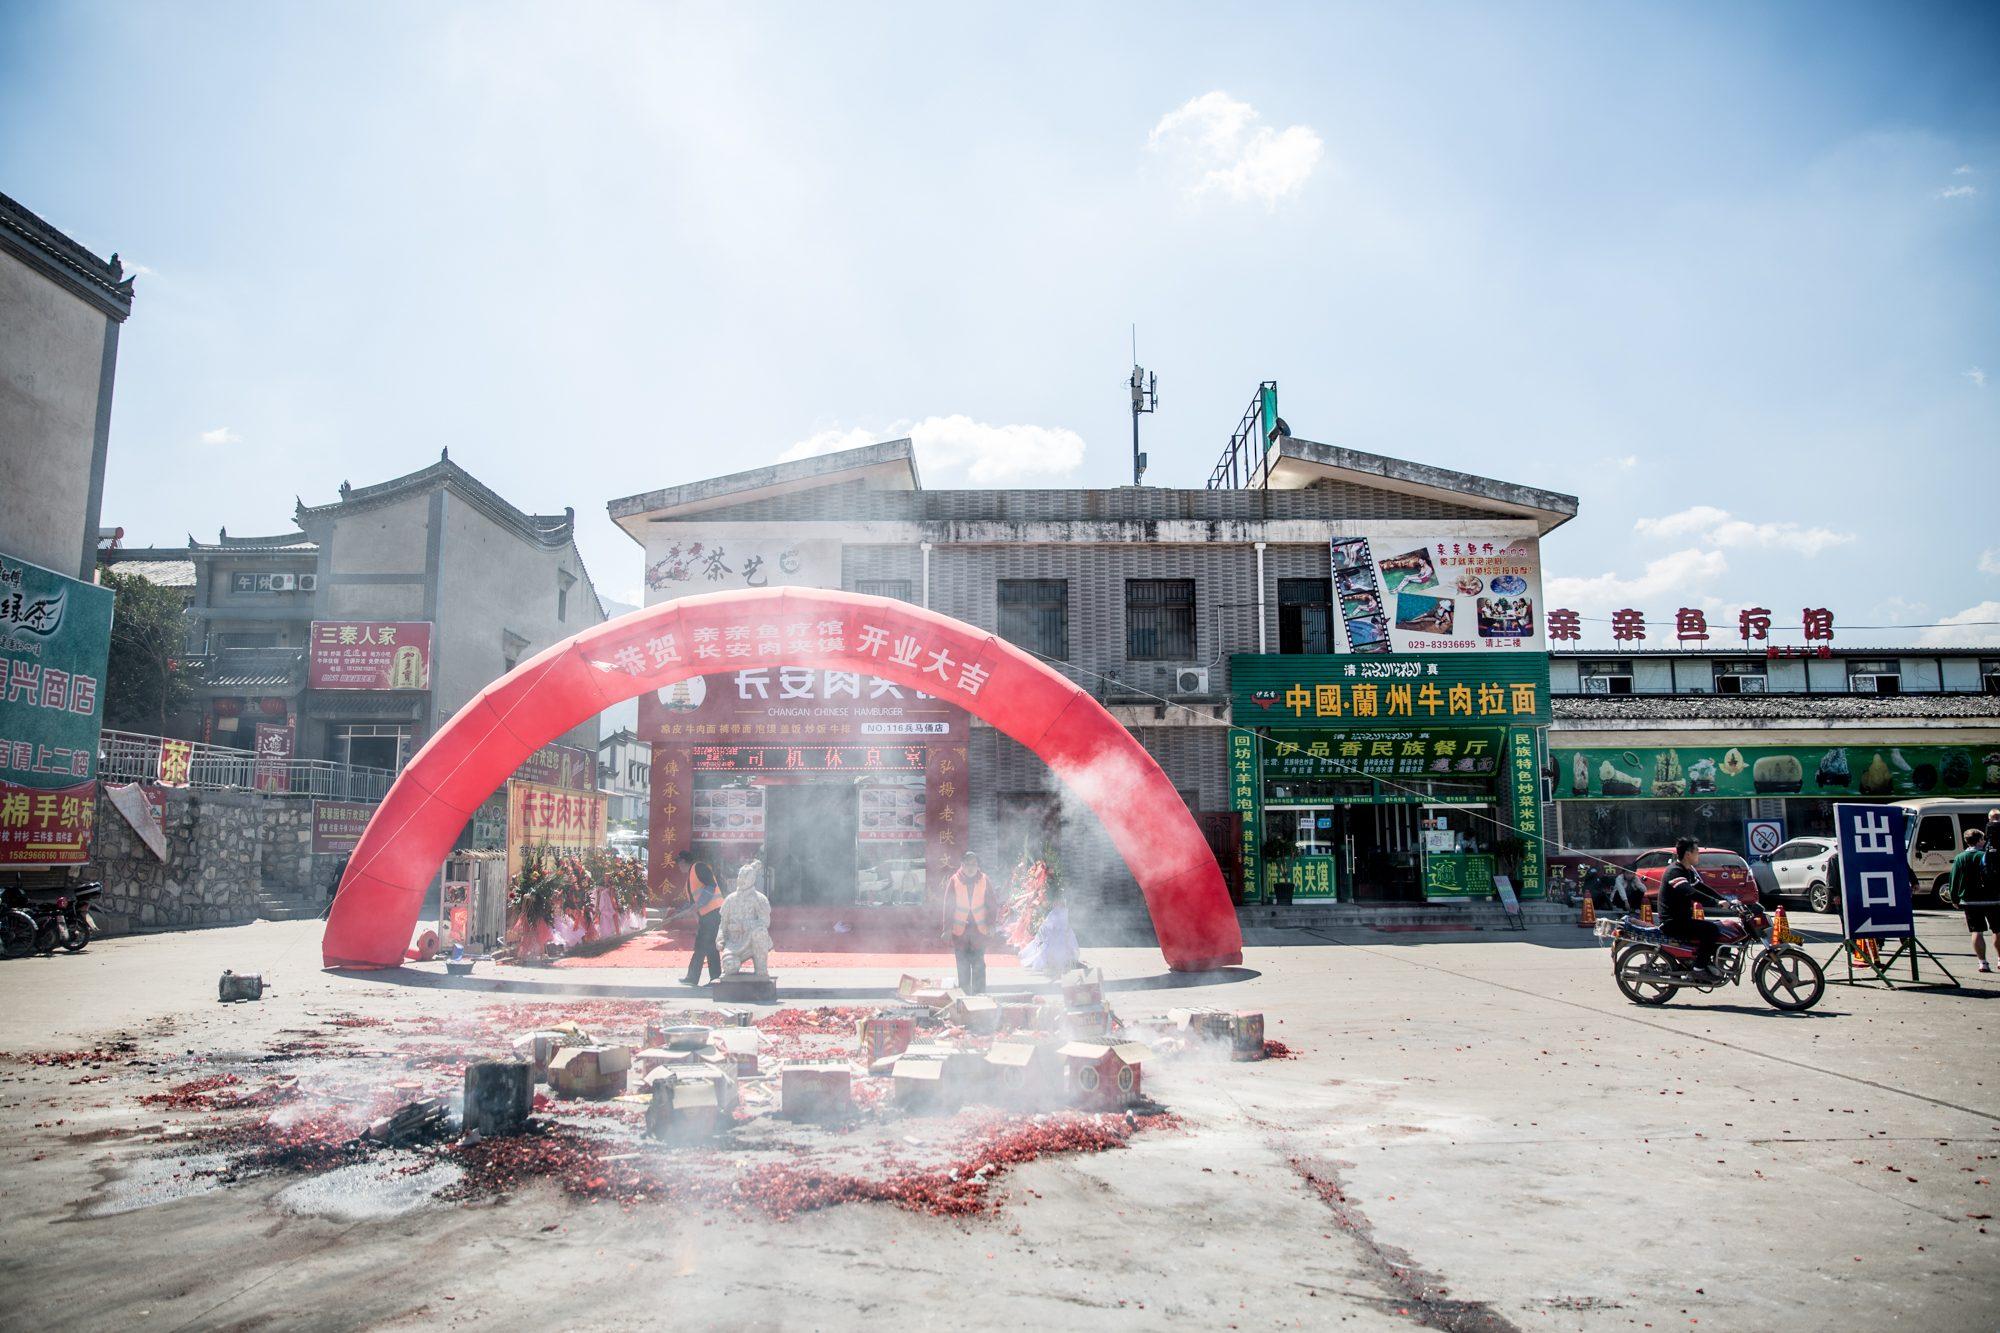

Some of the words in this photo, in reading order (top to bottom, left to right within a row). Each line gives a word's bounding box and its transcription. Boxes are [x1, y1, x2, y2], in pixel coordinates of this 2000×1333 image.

[0, 560, 22, 588] 师傅
[703, 546, 768, 587] 茶艺
[320, 626, 397, 645] 三秦人家
[694, 620, 845, 643] 亲亲鱼疗馆
[1548, 607, 1834, 641] 亲亲鱼疗馆
[614, 634, 682, 677] 恭贺
[1408, 640, 1476, 649] 029-83936695
[1485, 638, 1521, 648] 请上二楼
[857, 625, 990, 697] 开业大吉
[1344, 664, 1356, 676] 清
[1427, 663, 1439, 675] 真
[768, 707, 810, 717] CHANGAN
[814, 707, 848, 716] CHINESE
[854, 707, 903, 716] HAMBURGER
[162, 740, 190, 783] 茶
[1275, 740, 1488, 756] 伊品香民族餐厅
[1515, 733, 1536, 832] 民族特色炒菜米饭
[33, 831, 53, 842] 三件套
[1854, 811, 1896, 908] 出口
[1267, 862, 1329, 896] 腊肉夹馍
